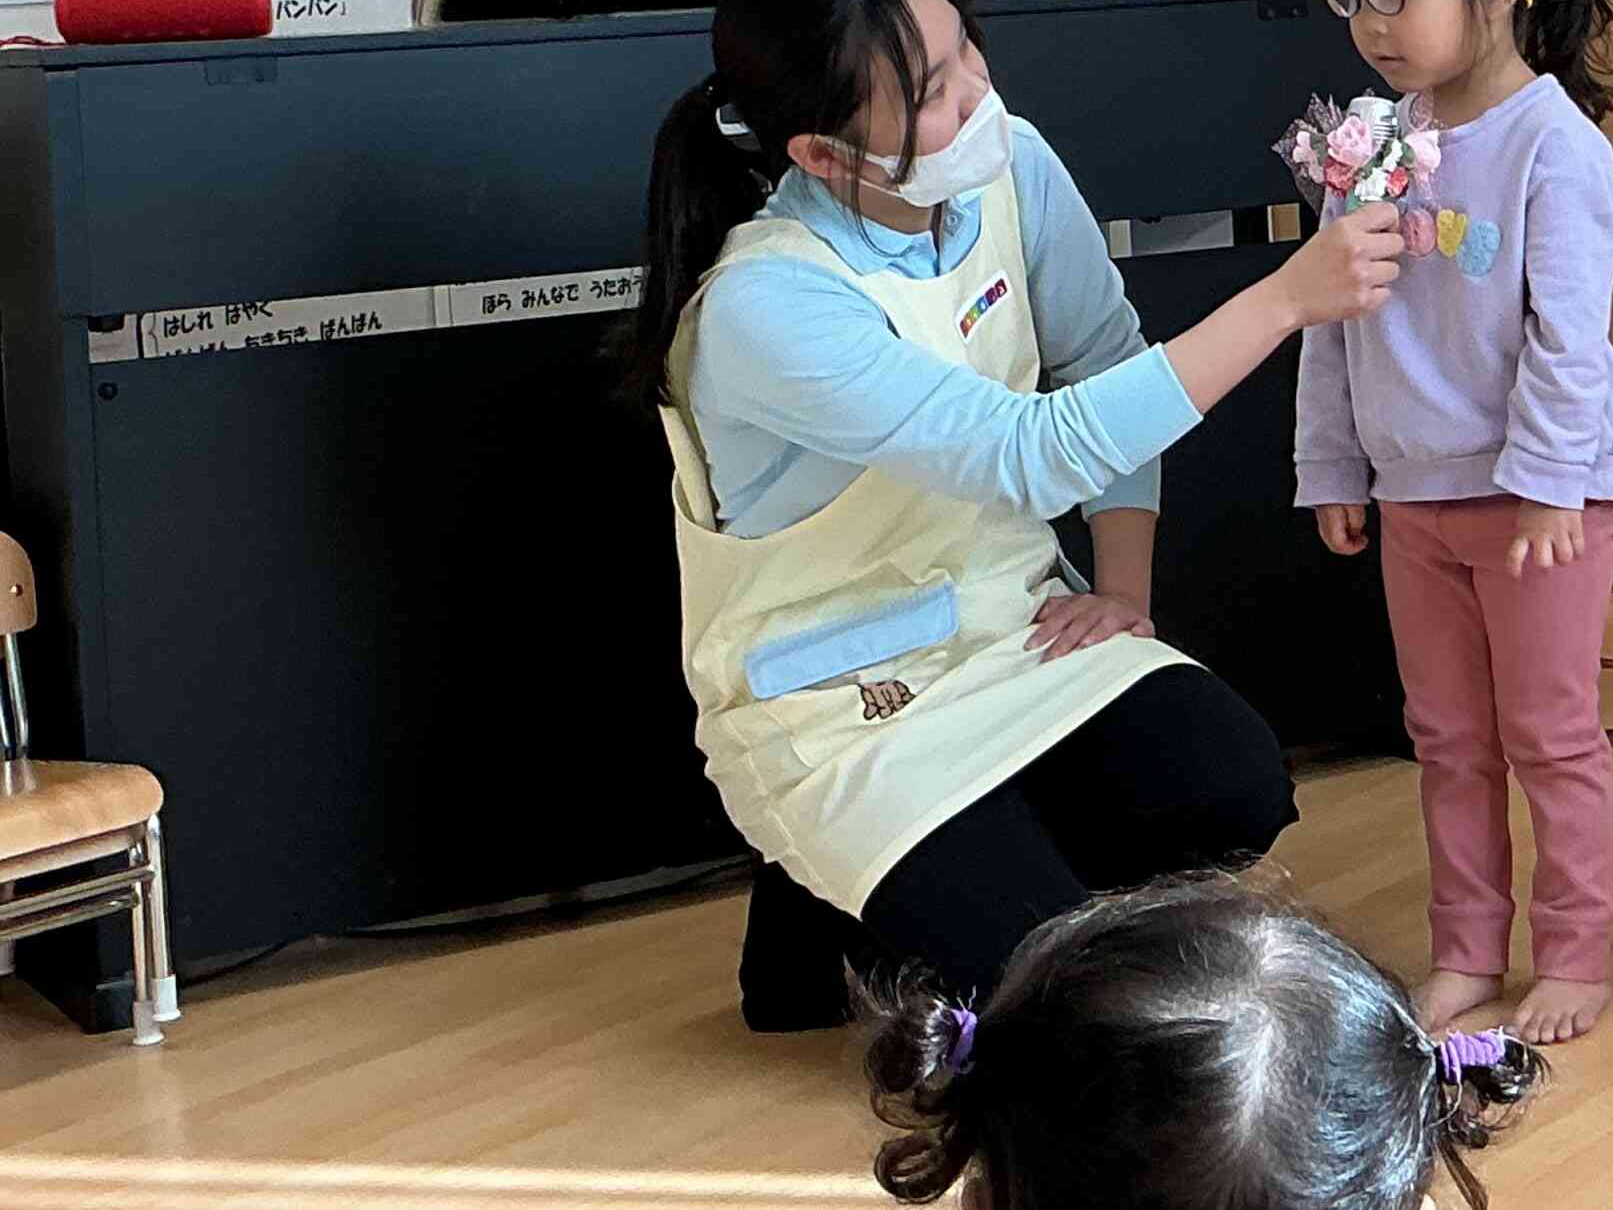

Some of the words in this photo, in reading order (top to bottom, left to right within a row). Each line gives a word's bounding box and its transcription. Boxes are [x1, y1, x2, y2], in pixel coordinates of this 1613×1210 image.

[482, 294, 511, 314] ほら
[521, 284, 579, 308] みんなで
[163, 313, 213, 338] はしれ
[225, 300, 273, 325] はやく
